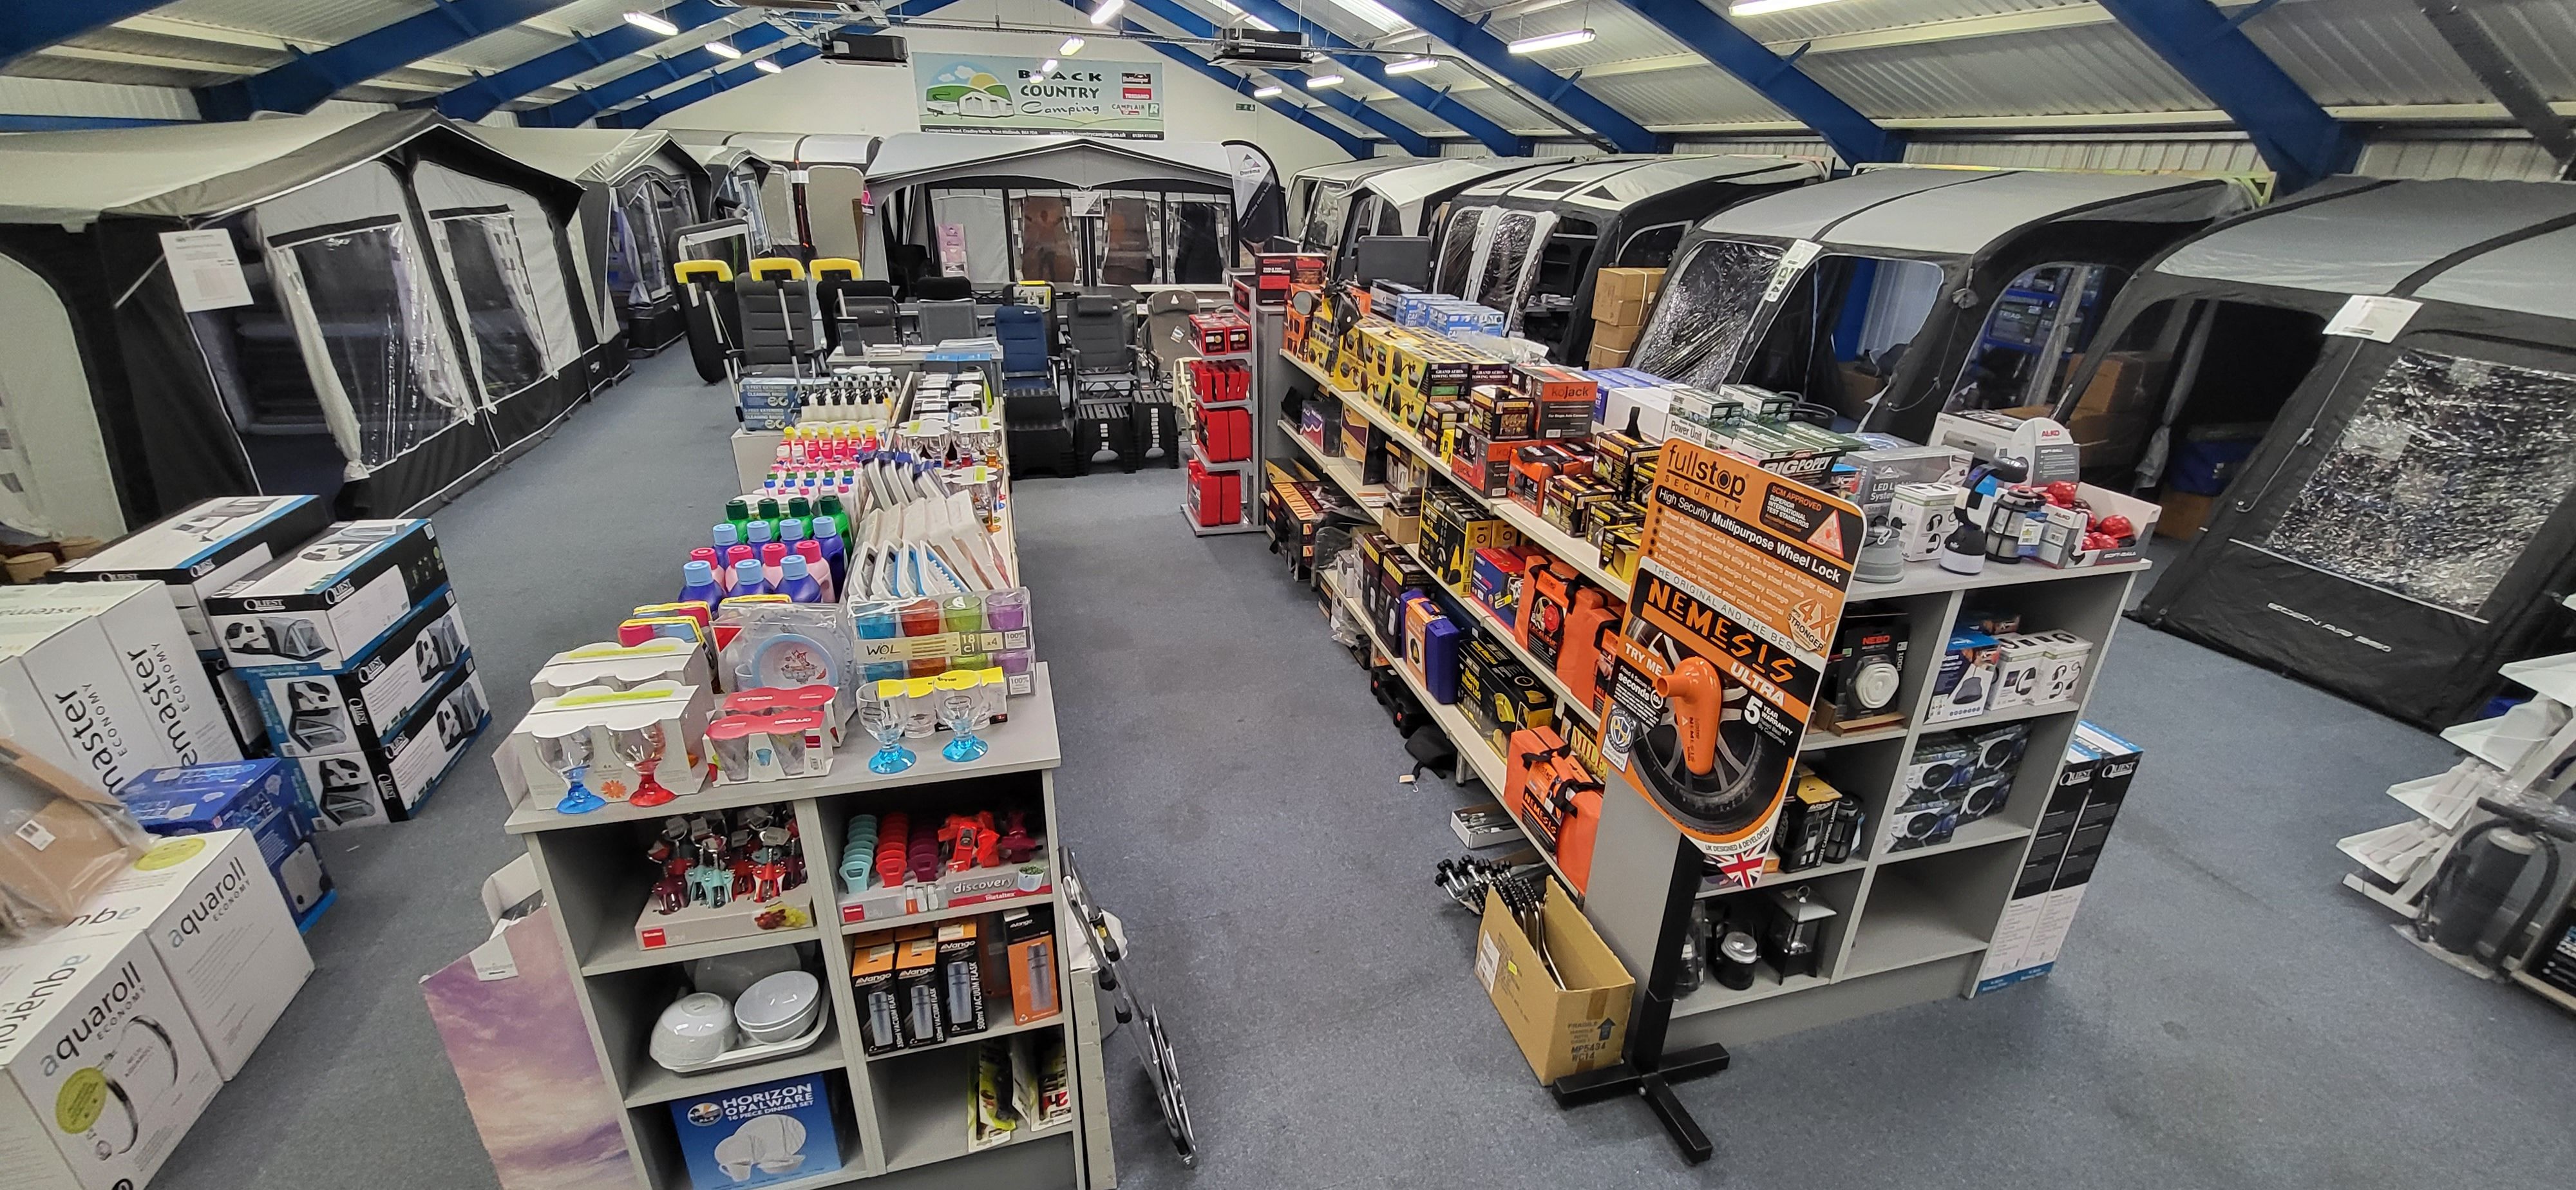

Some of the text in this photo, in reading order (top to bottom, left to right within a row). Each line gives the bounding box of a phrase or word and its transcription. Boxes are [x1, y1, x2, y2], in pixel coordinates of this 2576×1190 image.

[1018, 70, 1103, 82] BACK
[1020, 85, 1099, 99] COUNTRY
[1021, 101, 1099, 115] Camping
[1671, 420, 1689, 435] Power
[1690, 426, 1702, 442] Unit
[1668, 444, 1746, 497] fullstop
[1665, 475, 1740, 513] SECURITY
[1772, 486, 1822, 511] SCM APPROVED
[1873, 483, 1888, 492] LED
[1768, 500, 1807, 521] INTERNATIONAL
[1769, 495, 1795, 509] SUPERIOR
[1766, 505, 1779, 515] TEST
[1779, 511, 1810, 528] STANDARDS
[1659, 487, 1677, 505] High
[1678, 496, 1710, 522] Security
[1711, 512, 1775, 551] Multipurpose
[1776, 542, 1811, 568] Wheel
[1811, 559, 1841, 583] Lock
[1662, 520, 1685, 536] Universal
[1723, 550, 1732, 560] for
[1731, 554, 1745, 568] alloy
[1750, 565, 1767, 578] some
[1767, 574, 1783, 587] steel
[1783, 581, 1804, 598] wheels
[1712, 533, 1726, 544] Lock
[1727, 540, 1736, 549] for
[1736, 545, 1762, 563] caravans,
[1763, 558, 1783, 573] trailers
[1784, 569, 1797, 580] and
[1797, 575, 1816, 589] trailer
[1816, 585, 1834, 599] tents
[325, 578, 355, 605] QUEST
[1719, 576, 1735, 588] wheel
[1734, 583, 1756, 600] rotation
[1761, 600, 1785, 616] removal
[1742, 575, 1751, 583] for
[1751, 580, 1766, 593] easy
[1766, 589, 1789, 605] storage
[243, 598, 286, 611] QUEST
[1653, 564, 1802, 657] THE ORIGINAL AND THE BEST.
[1722, 590, 1736, 601] steel
[1736, 598, 1773, 623] construction
[1647, 578, 1797, 683] NEMESIS
[1786, 612, 1824, 652] STRONGER
[1798, 598, 1837, 643] 4X
[961, 634, 975, 644] 18
[1862, 635, 1891, 645] NEBO
[357, 655, 386, 684] QUEST
[1625, 643, 1663, 677] TRY ME
[151, 643, 190, 712] ECONOMY
[1618, 673, 1650, 701] seconds
[1730, 661, 1785, 707] ULTRA
[82, 683, 128, 757] ECONOMY
[348, 698, 368, 726] QUEST
[1744, 695, 1763, 724] 5
[1763, 705, 1778, 719] YEAR
[1757, 722, 1786, 746] By Customers
[1761, 711, 1794, 736] WARRANTY
[1772, 726, 1782, 737] Best
[384, 730, 410, 760] QUEST
[2060, 769, 2093, 786] QUEST
[2102, 762, 2136, 778] QUEST
[377, 773, 397, 800] QUEST
[1524, 792, 1557, 834] NEMESIS
[1743, 826, 1770, 847] DEVELOPED
[953, 876, 1014, 895] discovery
[168, 857, 247, 949] aquaroll
[213, 879, 252, 922] ECONOMY
[1010, 919, 1033, 929] Vango
[940, 940, 976, 952] Vango
[856, 972, 892, 987] Vango
[899, 967, 934, 979] Vango
[969, 962, 986, 1030] 500ml VACUUM FLASK
[41, 961, 142, 1077] aquaroll
[97, 985, 147, 1041] ECONOMY
[891, 1009, 902, 1034] VACUUM
[933, 1003, 942, 1028] VACUUM
[722, 1083, 812, 1108] HORIZON
[725, 1092, 813, 1116] OPALWARE
[739, 1110, 763, 1119] PIECE
[764, 1103, 797, 1114] DINNER
